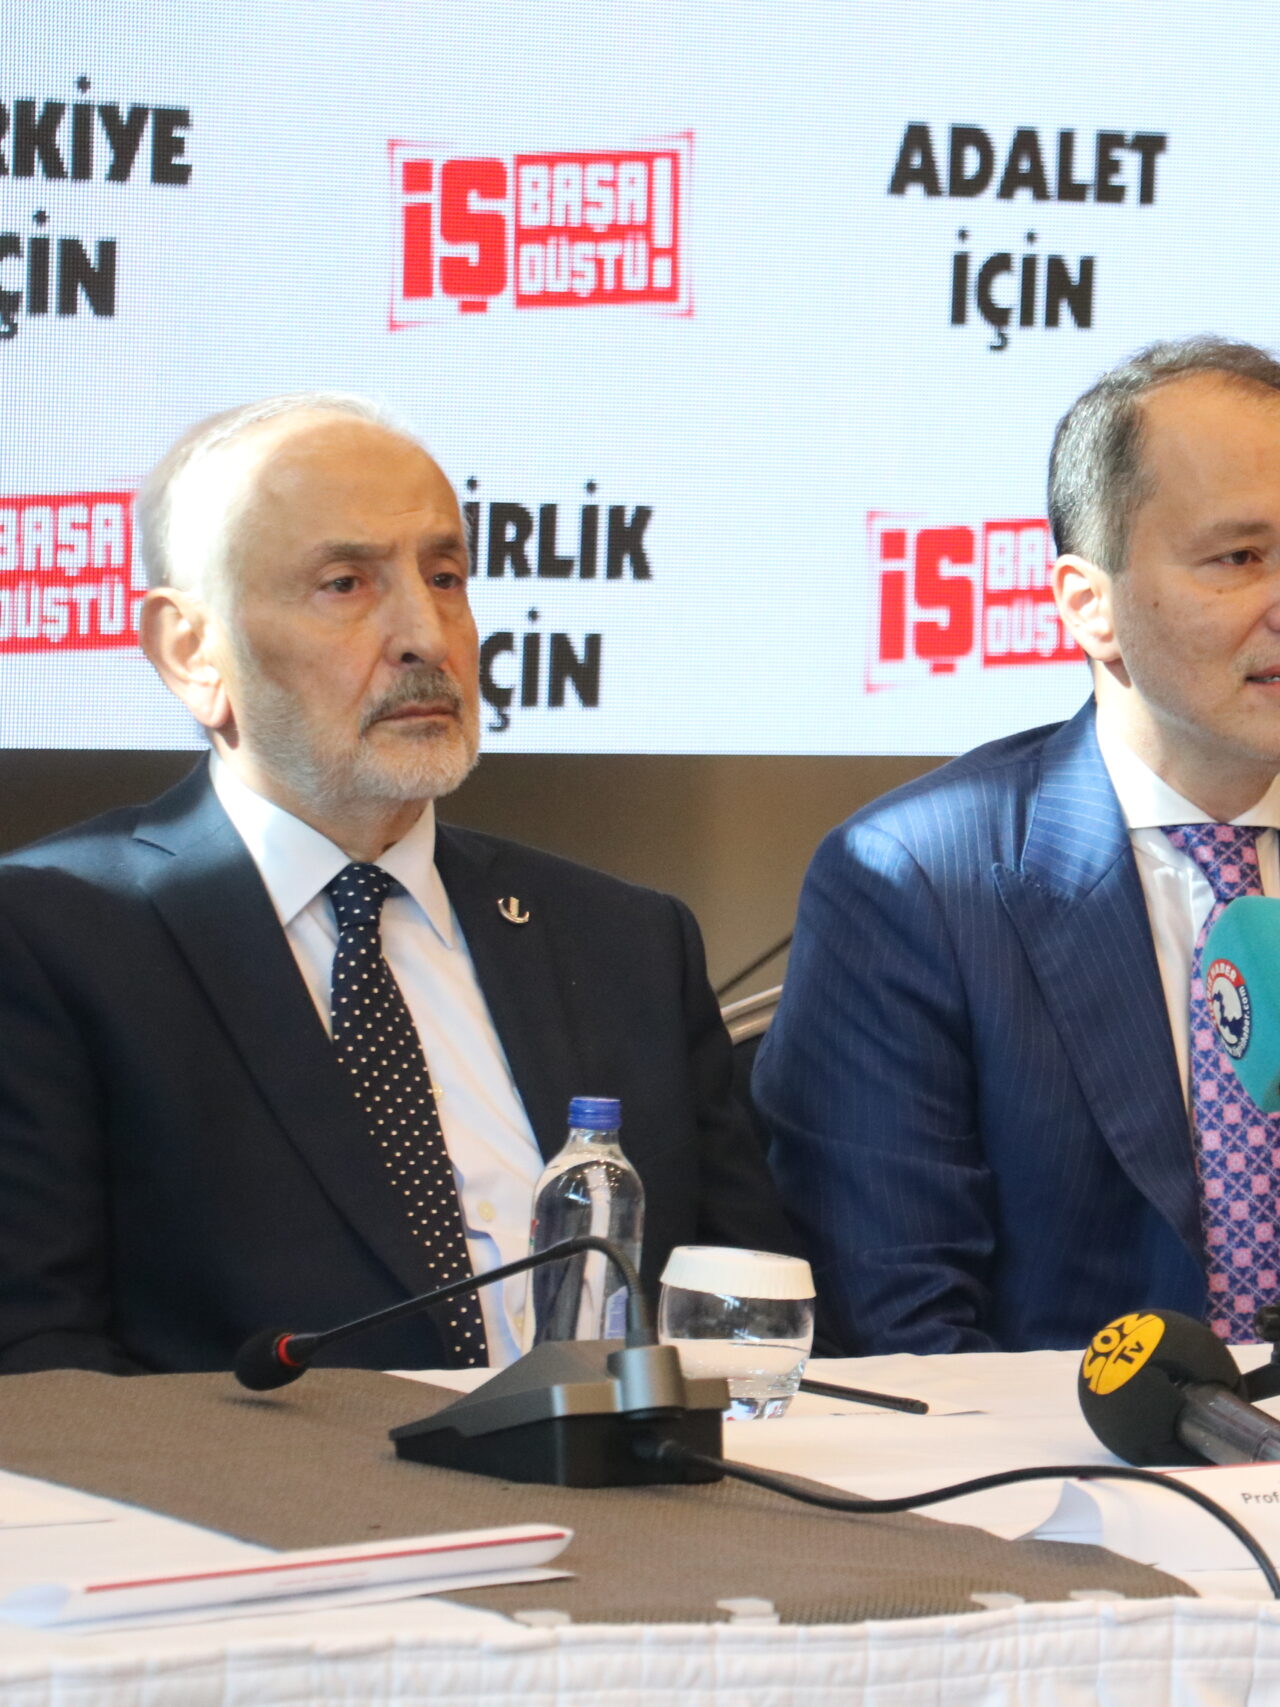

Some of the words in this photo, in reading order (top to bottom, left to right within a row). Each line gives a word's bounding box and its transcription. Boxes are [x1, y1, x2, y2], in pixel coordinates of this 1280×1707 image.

[0, 76, 193, 186] KİYE
[888, 121, 1168, 206] ADALET
[402, 158, 508, 315] İŞ
[518, 160, 649, 234] BAŞA
[951, 227, 1096, 352] İÇİN
[878, 525, 975, 675] İŞ
[986, 526, 1057, 594] BA
[1112, 1340, 1145, 1365] TV
